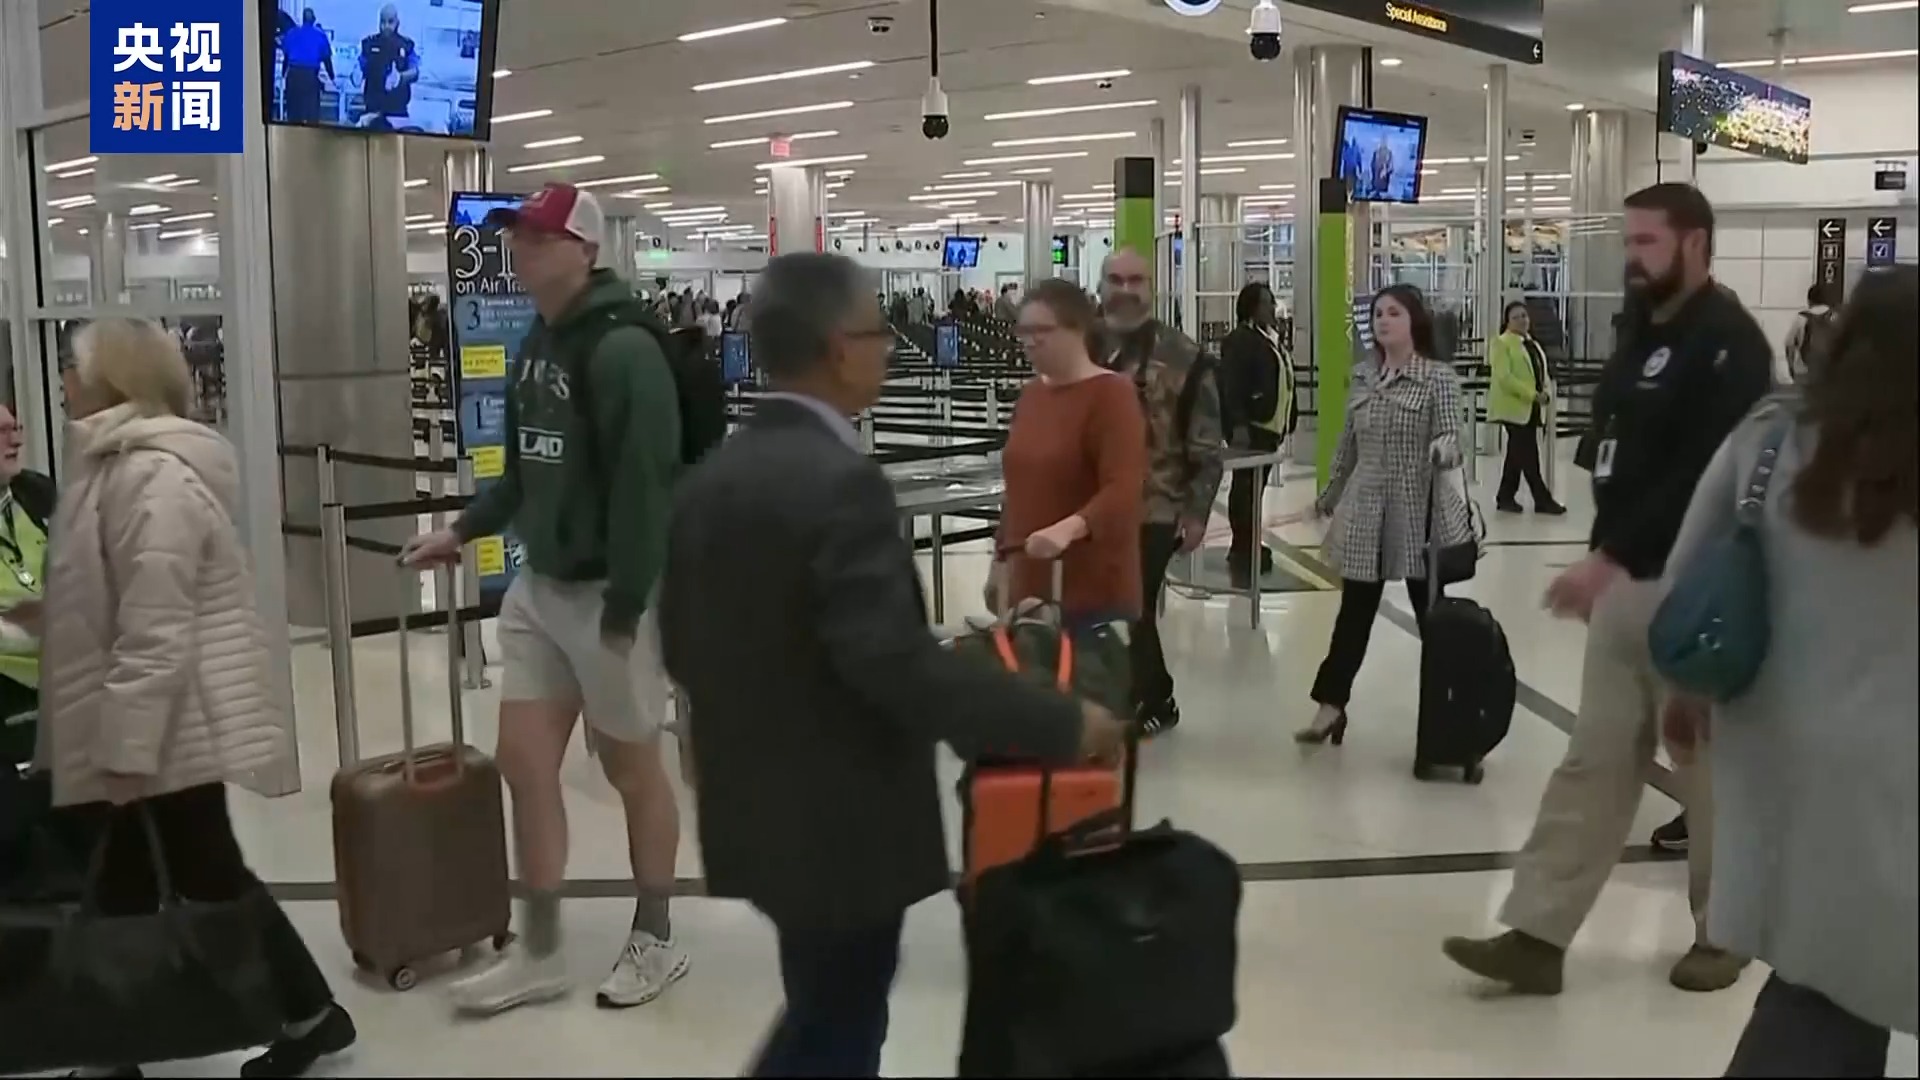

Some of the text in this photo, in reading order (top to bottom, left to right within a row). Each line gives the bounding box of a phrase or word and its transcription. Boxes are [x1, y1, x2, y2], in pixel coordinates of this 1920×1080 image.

[1385, 1, 1447, 32] Special Assistance
[456, 280, 476, 294] on
[480, 277, 501, 294] Air
[466, 301, 481, 331] 3
